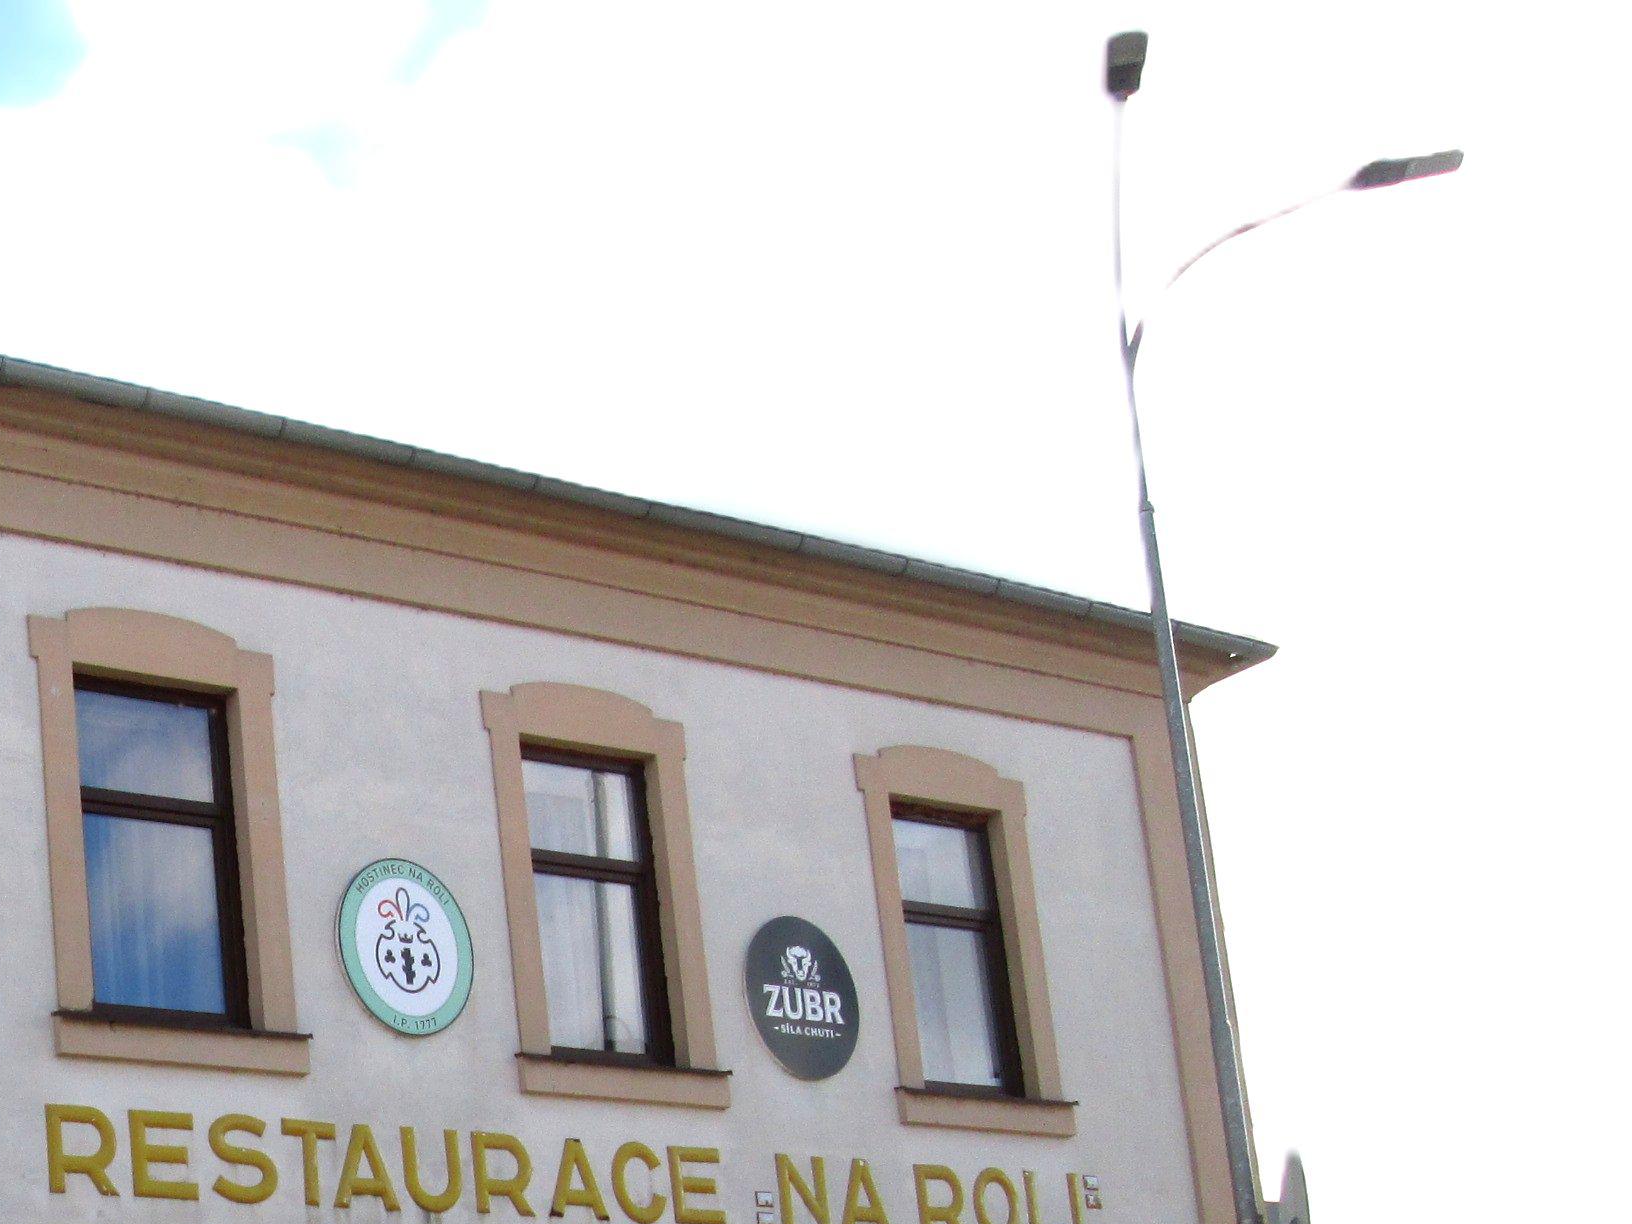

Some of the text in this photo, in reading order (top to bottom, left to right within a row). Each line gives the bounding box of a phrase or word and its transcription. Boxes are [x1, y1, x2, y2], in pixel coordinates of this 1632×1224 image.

[355, 864, 450, 906] HOSTINEC NA ROLI
[763, 983, 845, 1025] ZUBR
[804, 1026, 835, 1039] CHUTI
